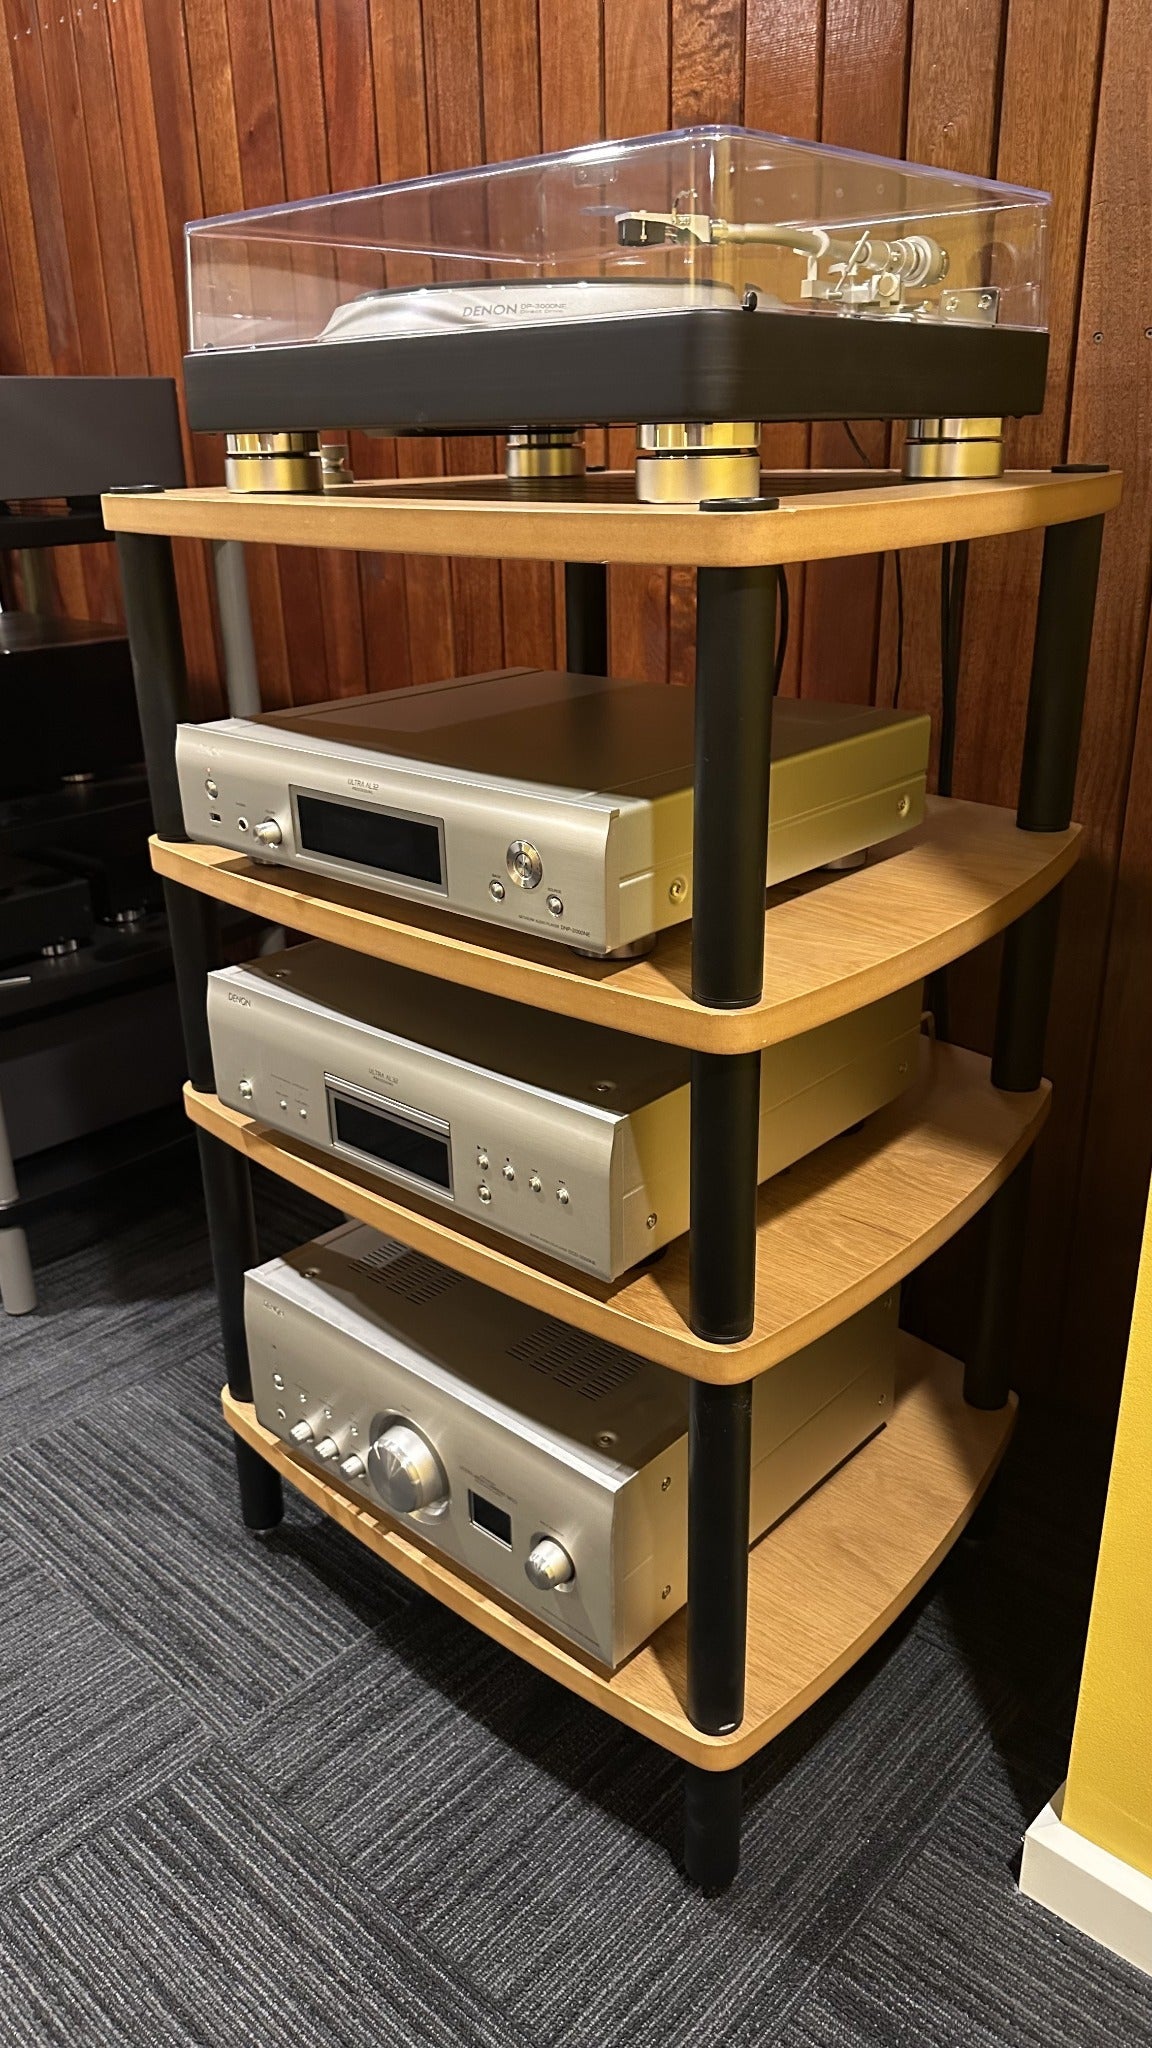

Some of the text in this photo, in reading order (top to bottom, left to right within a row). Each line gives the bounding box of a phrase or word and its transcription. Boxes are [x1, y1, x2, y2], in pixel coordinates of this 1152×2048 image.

[463, 304, 517, 317] DENON
[347, 778, 365, 788] ULTRA
[228, 991, 251, 1007] DENON
